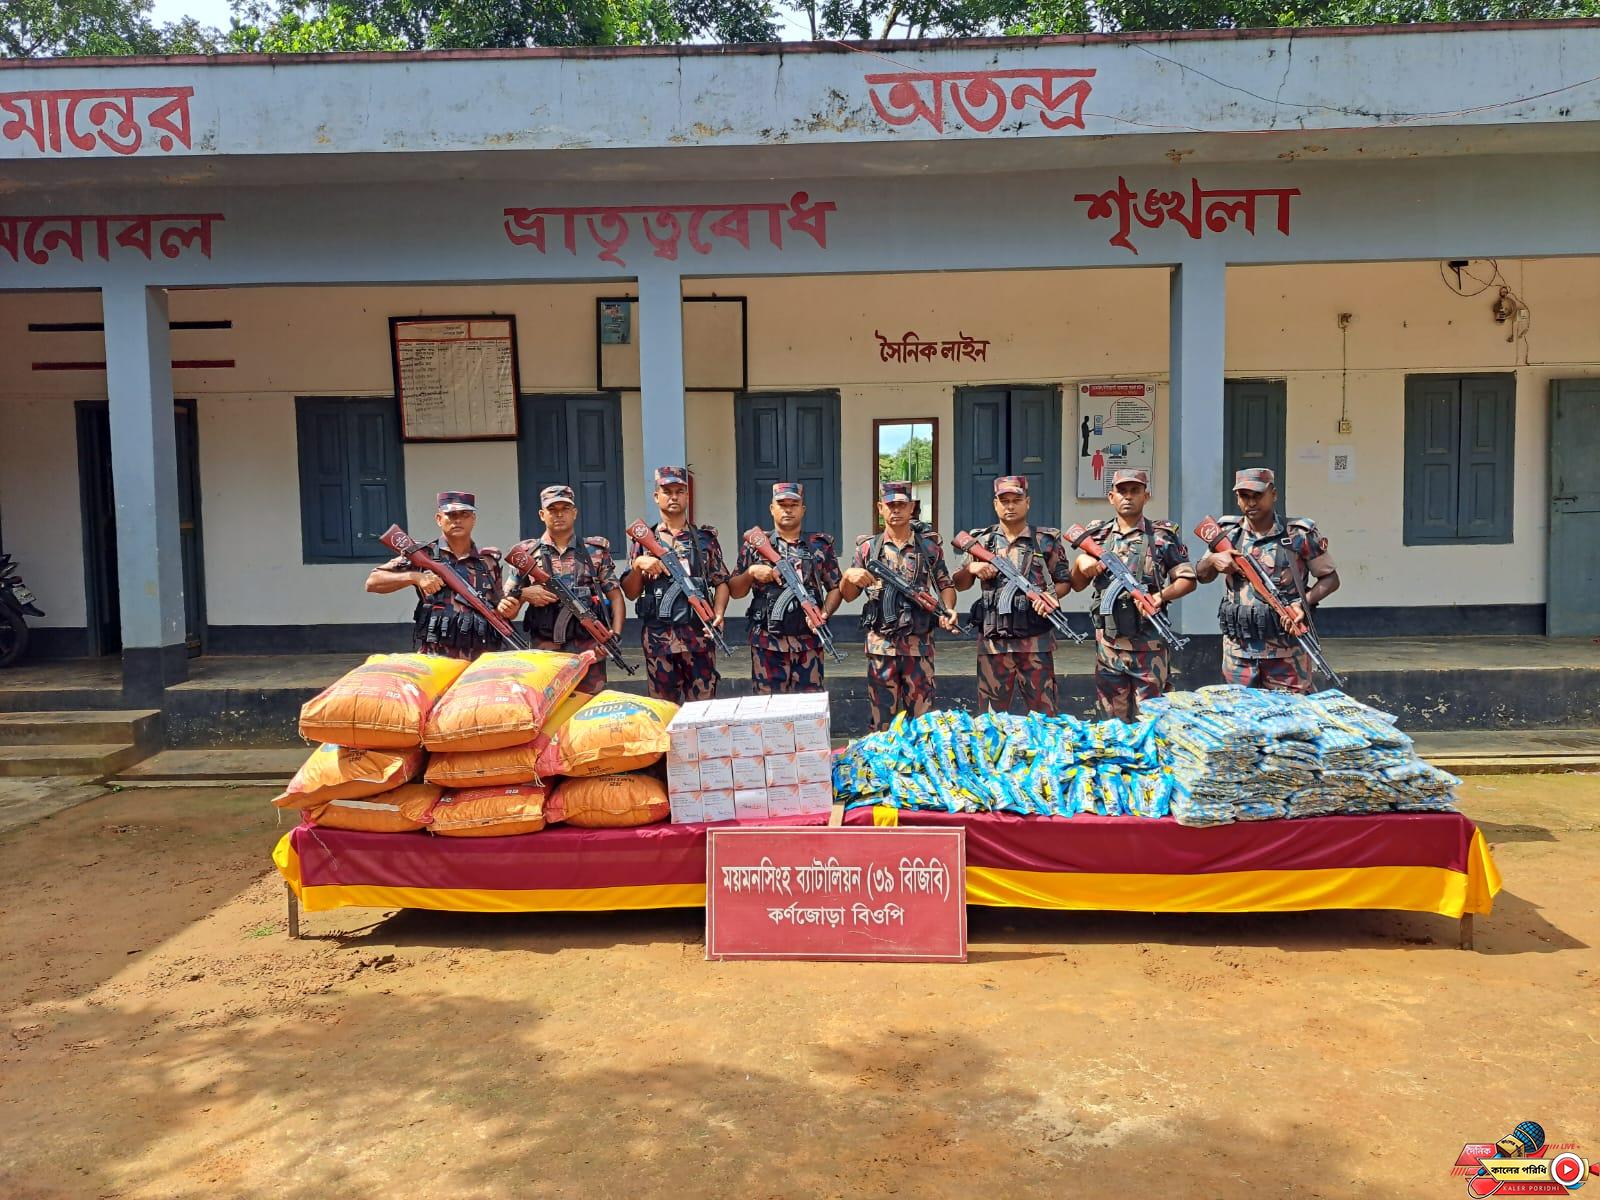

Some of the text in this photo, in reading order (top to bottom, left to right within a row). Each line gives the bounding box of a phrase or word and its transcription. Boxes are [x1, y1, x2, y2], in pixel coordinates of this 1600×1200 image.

[865, 69, 1096, 133] অতন্দ্র
[504, 191, 836, 267] ভ্রাতৃত্ববোধ
[875, 329, 991, 363] সৈনিক লাইন
[721, 856, 950, 903] ময়মনসিংহ ব্যাটালিয়ন (৩৯ বিজিবি)
[767, 901, 905, 928] কর্ণজোড়া বিওপি
